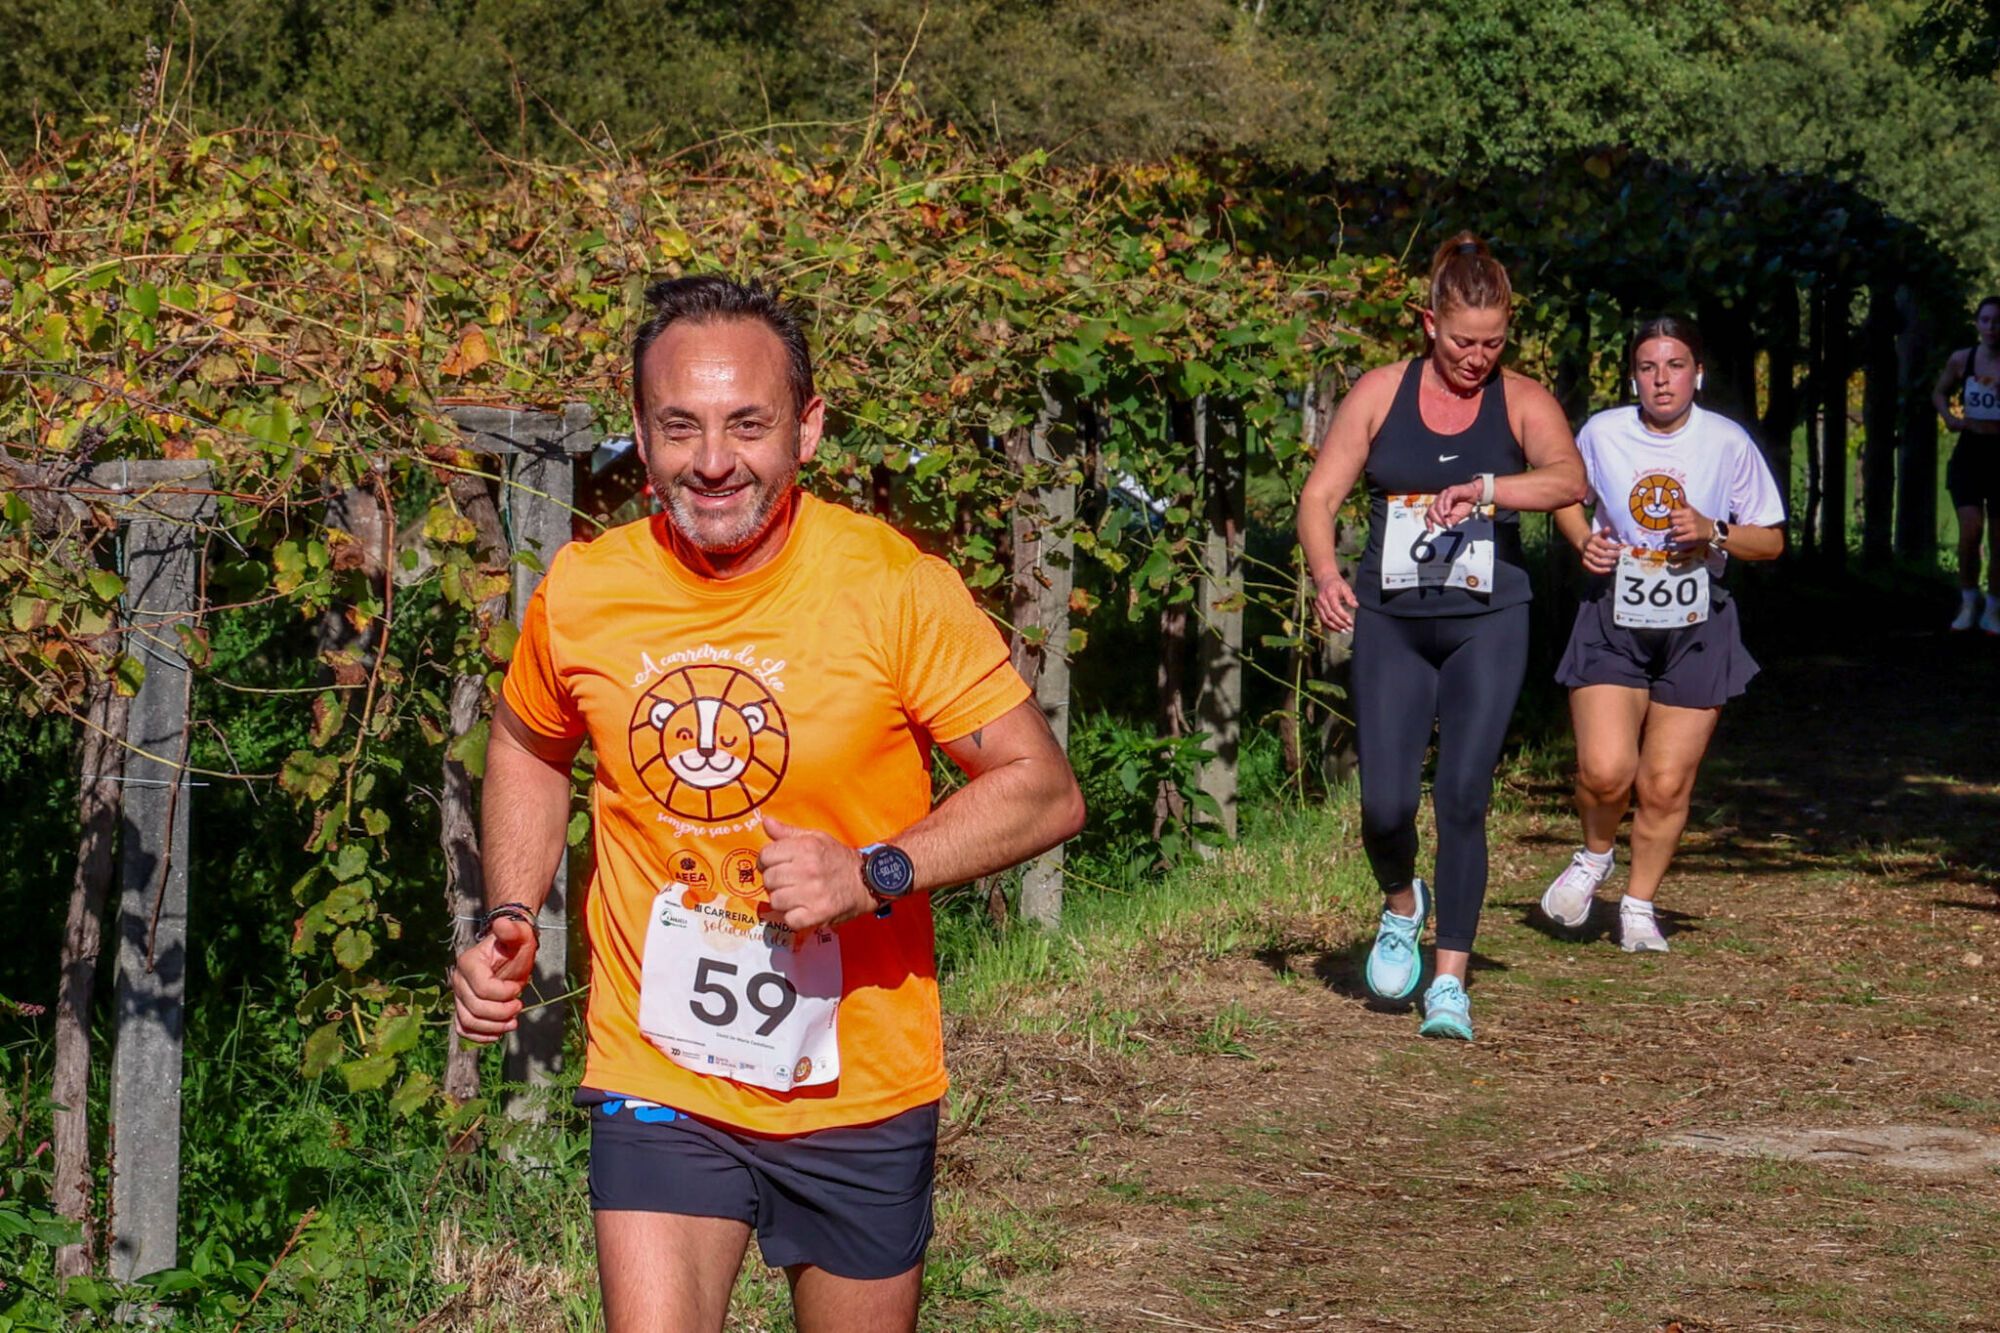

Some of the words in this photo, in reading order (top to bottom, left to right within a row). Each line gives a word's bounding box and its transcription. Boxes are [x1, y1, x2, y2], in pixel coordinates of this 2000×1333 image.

[1410, 531, 1465, 563] 67
[1622, 576, 1698, 607] 360
[632, 652, 664, 688] A
[660, 643, 733, 666] carreira
[734, 644, 756, 667] de
[753, 658, 787, 692] Leo
[703, 905, 755, 925] CARREIRA
[689, 957, 798, 1037] 59
